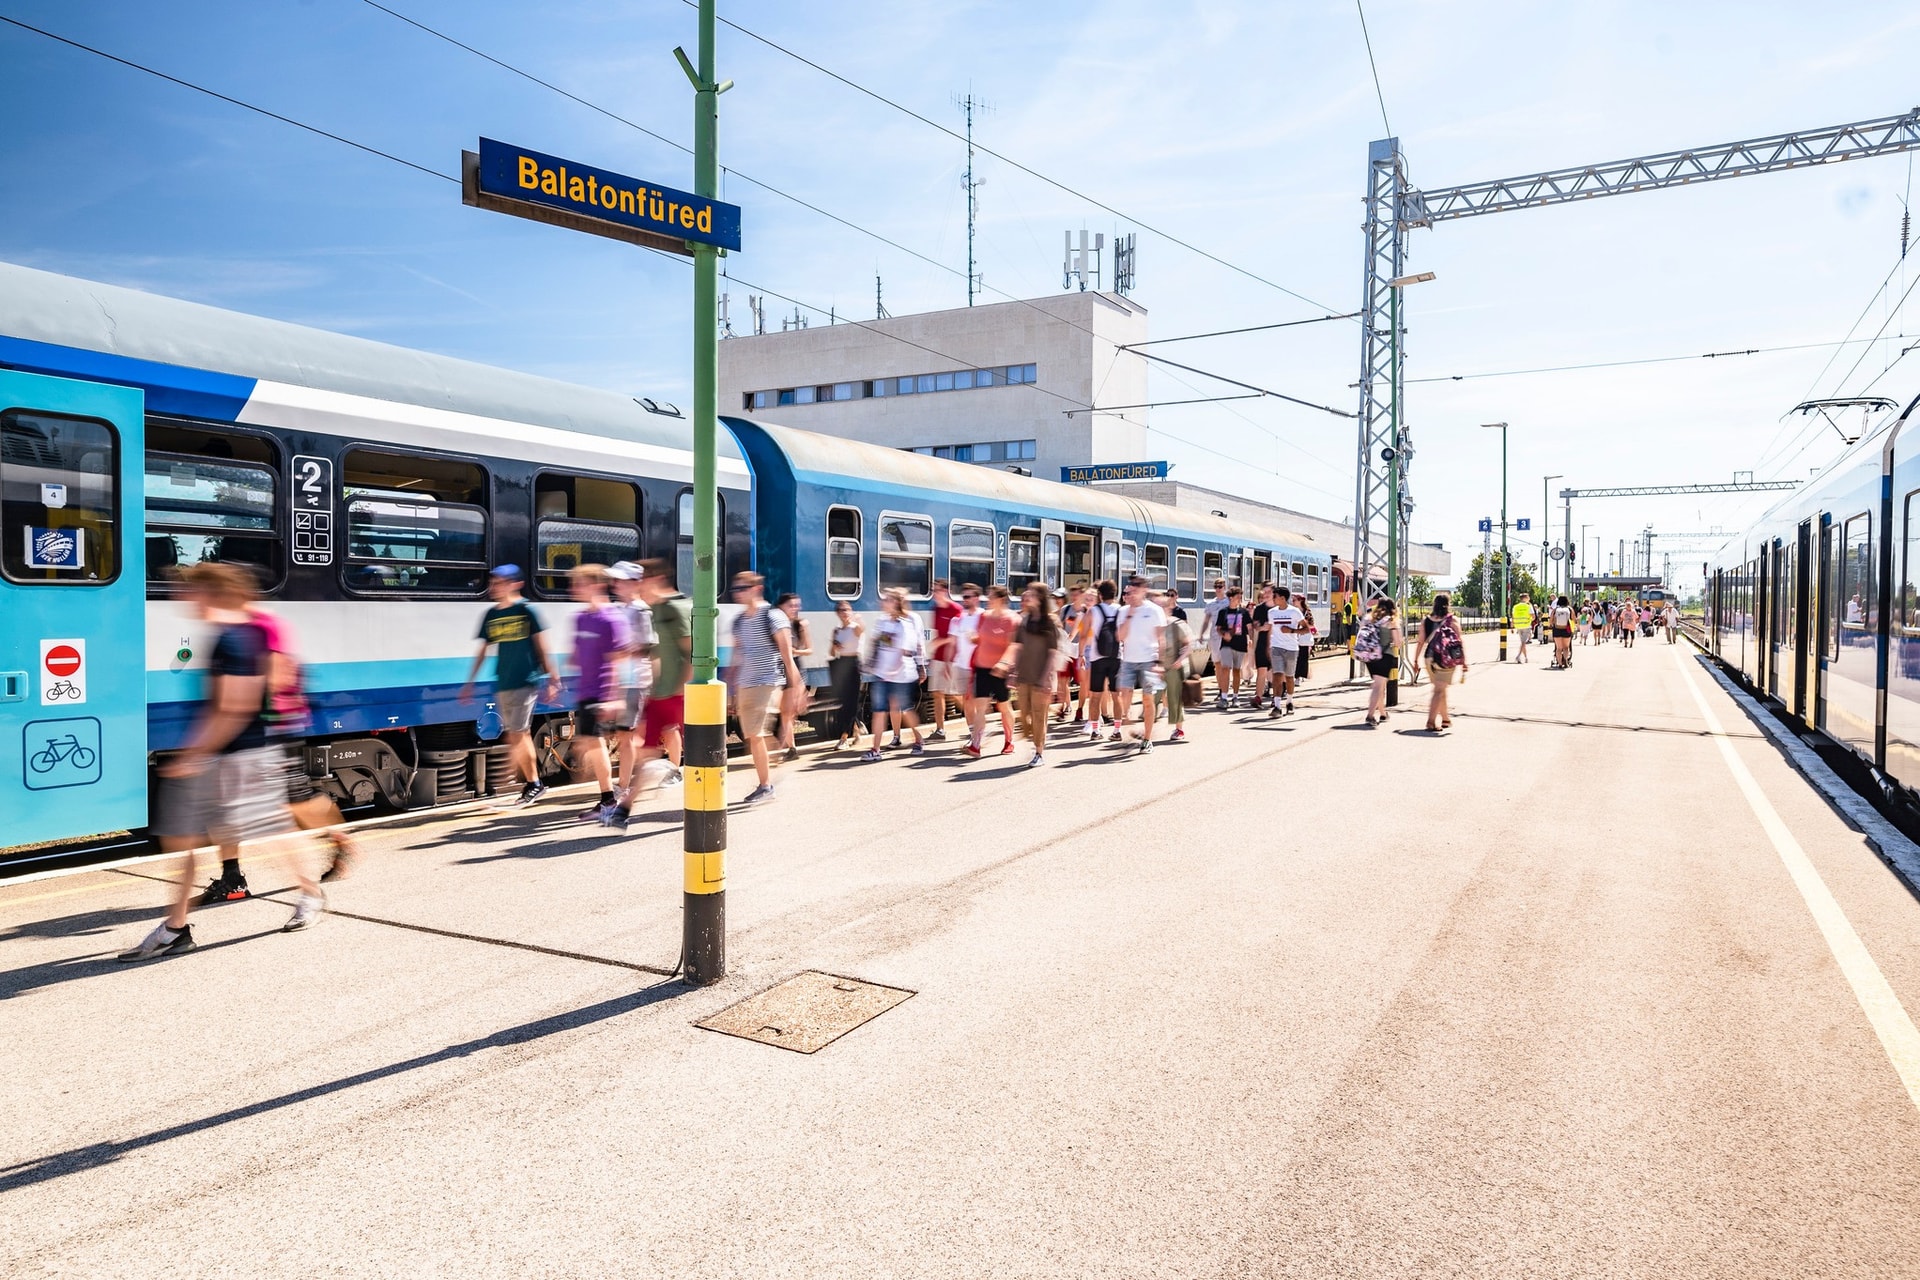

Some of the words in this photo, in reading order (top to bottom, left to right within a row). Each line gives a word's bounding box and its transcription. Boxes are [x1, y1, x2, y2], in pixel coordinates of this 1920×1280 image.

[517, 155, 713, 234] Balatonfüred
[302, 461, 322, 492] 2
[1070, 464, 1158, 481] BALATONFÜRED
[1482, 521, 1488, 529] 2
[1520, 520, 1527, 528] 3
[998, 534, 1005, 550] 2
